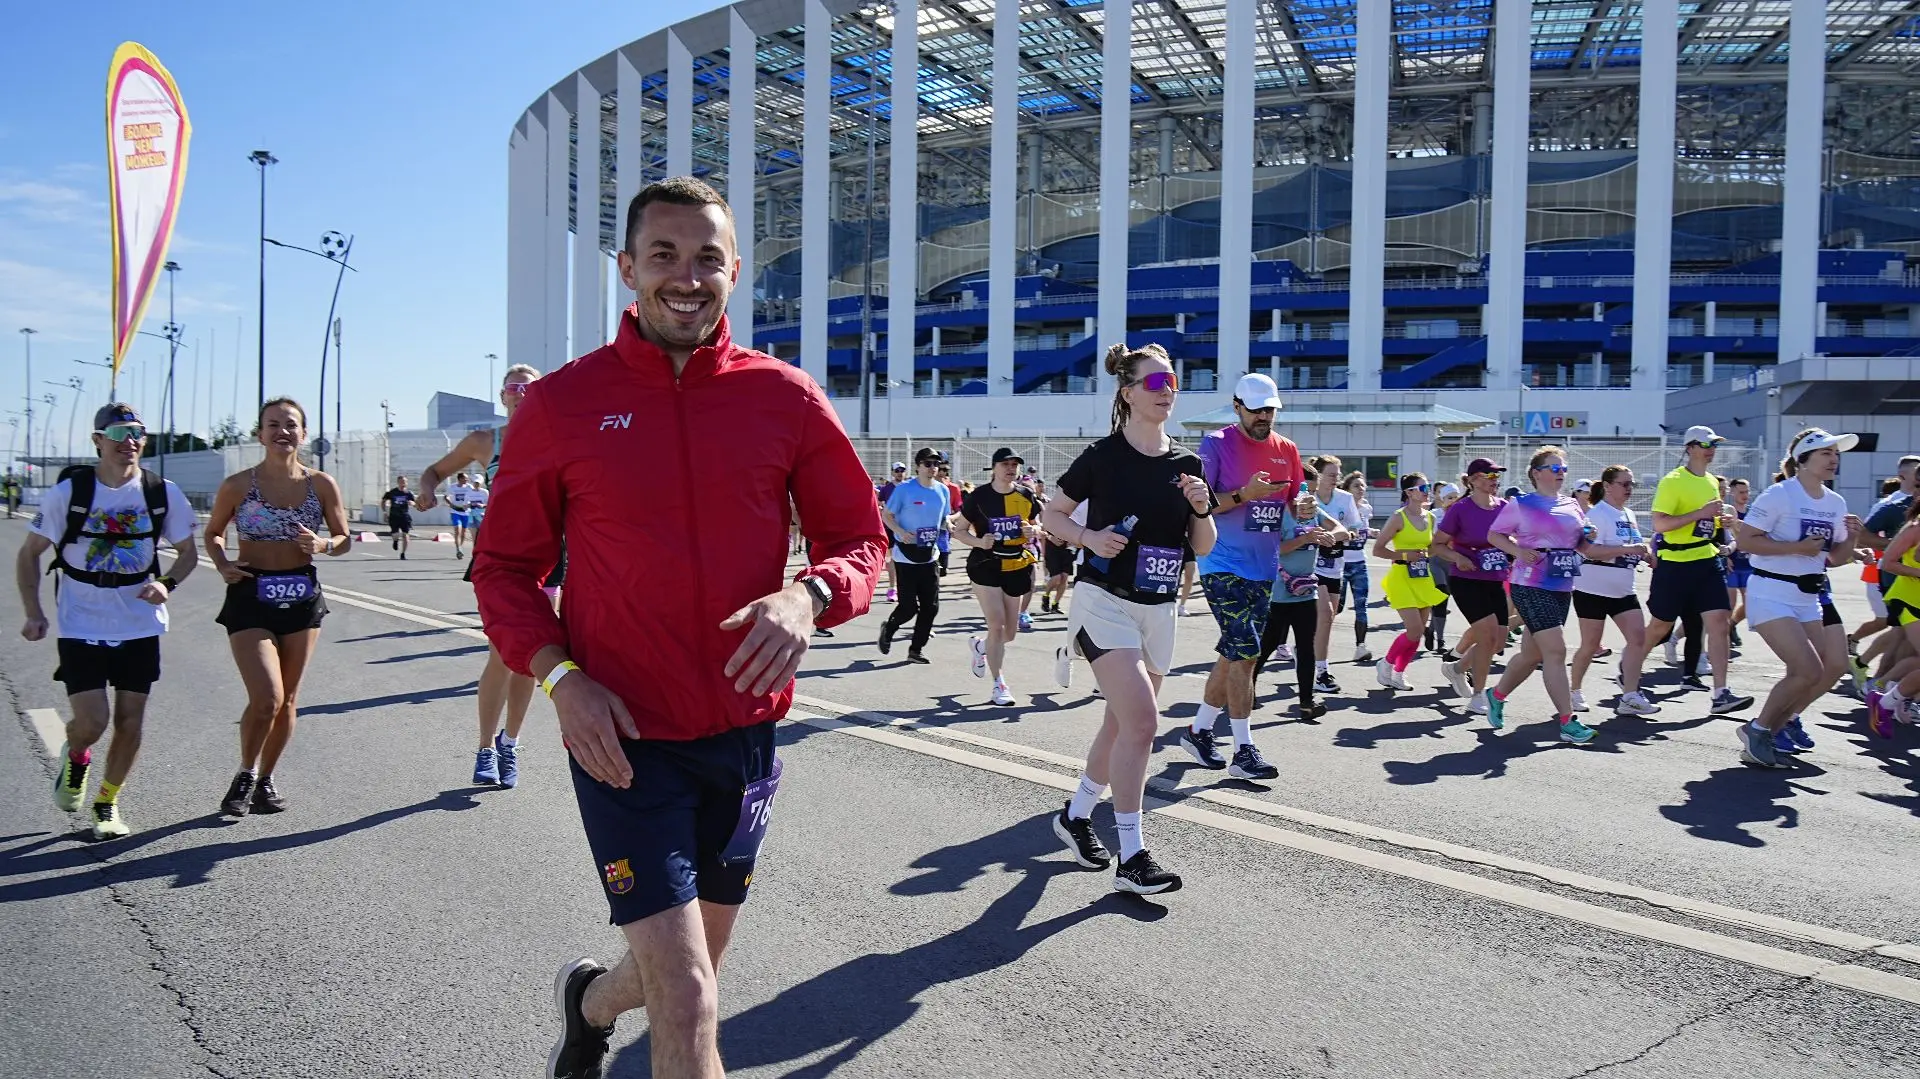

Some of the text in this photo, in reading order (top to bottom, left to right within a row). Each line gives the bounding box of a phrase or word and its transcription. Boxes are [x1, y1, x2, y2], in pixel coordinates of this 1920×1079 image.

[1513, 418, 1521, 428] E
[1527, 413, 1547, 433] A
[1552, 418, 1562, 428] C
[1252, 505, 1281, 519] 3404
[993, 520, 1019, 532] 7104
[265, 583, 307, 599] 3949
